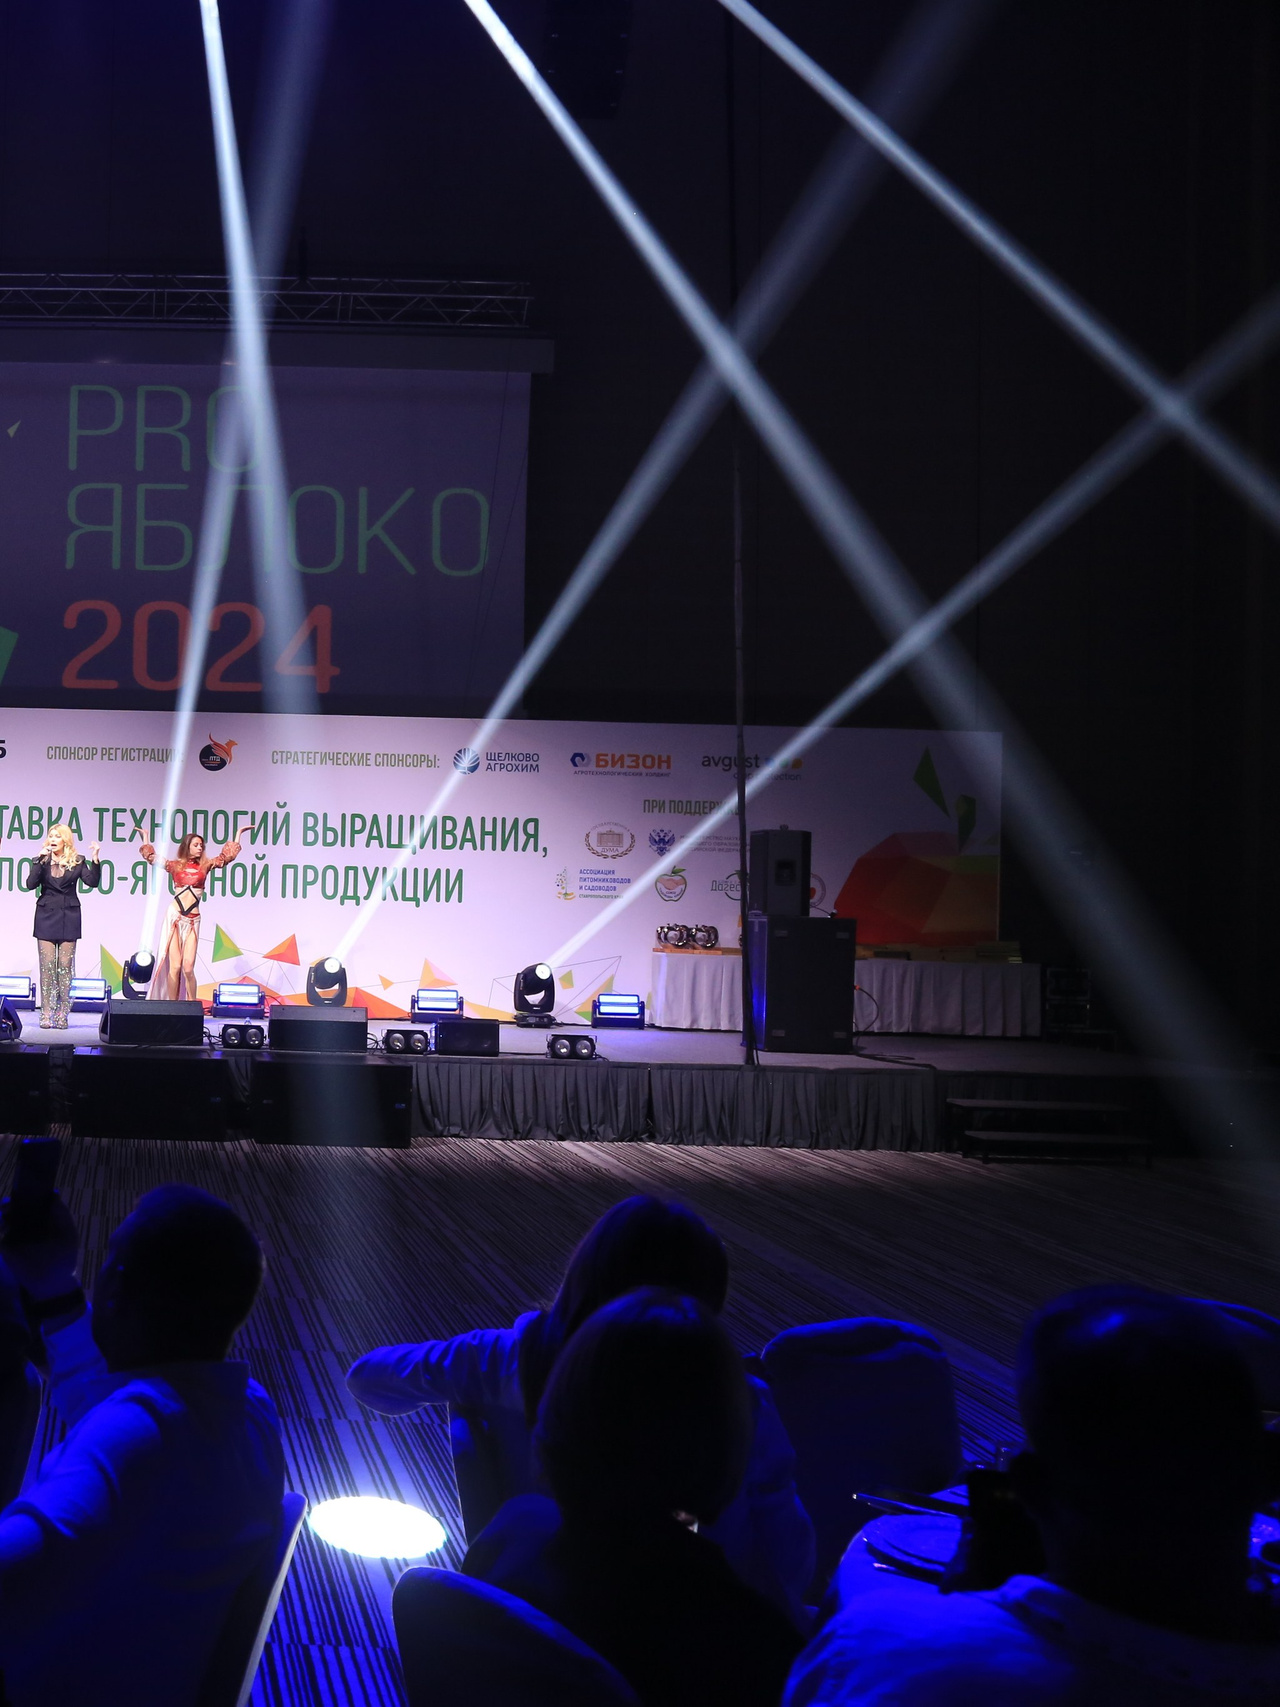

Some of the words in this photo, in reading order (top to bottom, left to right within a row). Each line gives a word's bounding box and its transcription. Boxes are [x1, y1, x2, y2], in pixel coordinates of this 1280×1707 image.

[67, 384, 264, 474] PRO
[65, 482, 491, 577] ЯБЛОКО
[61, 599, 341, 694] 2024
[46, 745, 98, 761] СПОНСОР
[271, 750, 372, 767] СТРАТЕГИЧЕСКИЕ
[374, 753, 441, 769] СПОНСОРЫ:
[485, 752, 540, 763] ЩЕЛКОВО
[595, 753, 672, 770] БИЗОН
[485, 762, 540, 773] АГРОХИМ
[643, 799, 666, 813] ПРИ
[302, 811, 548, 858] ВЫРАЩИВАНИЯ,
[579, 868, 616, 876] АССОЦИАЦИЯ
[281, 864, 463, 908] ПРОДУКЦИИ
